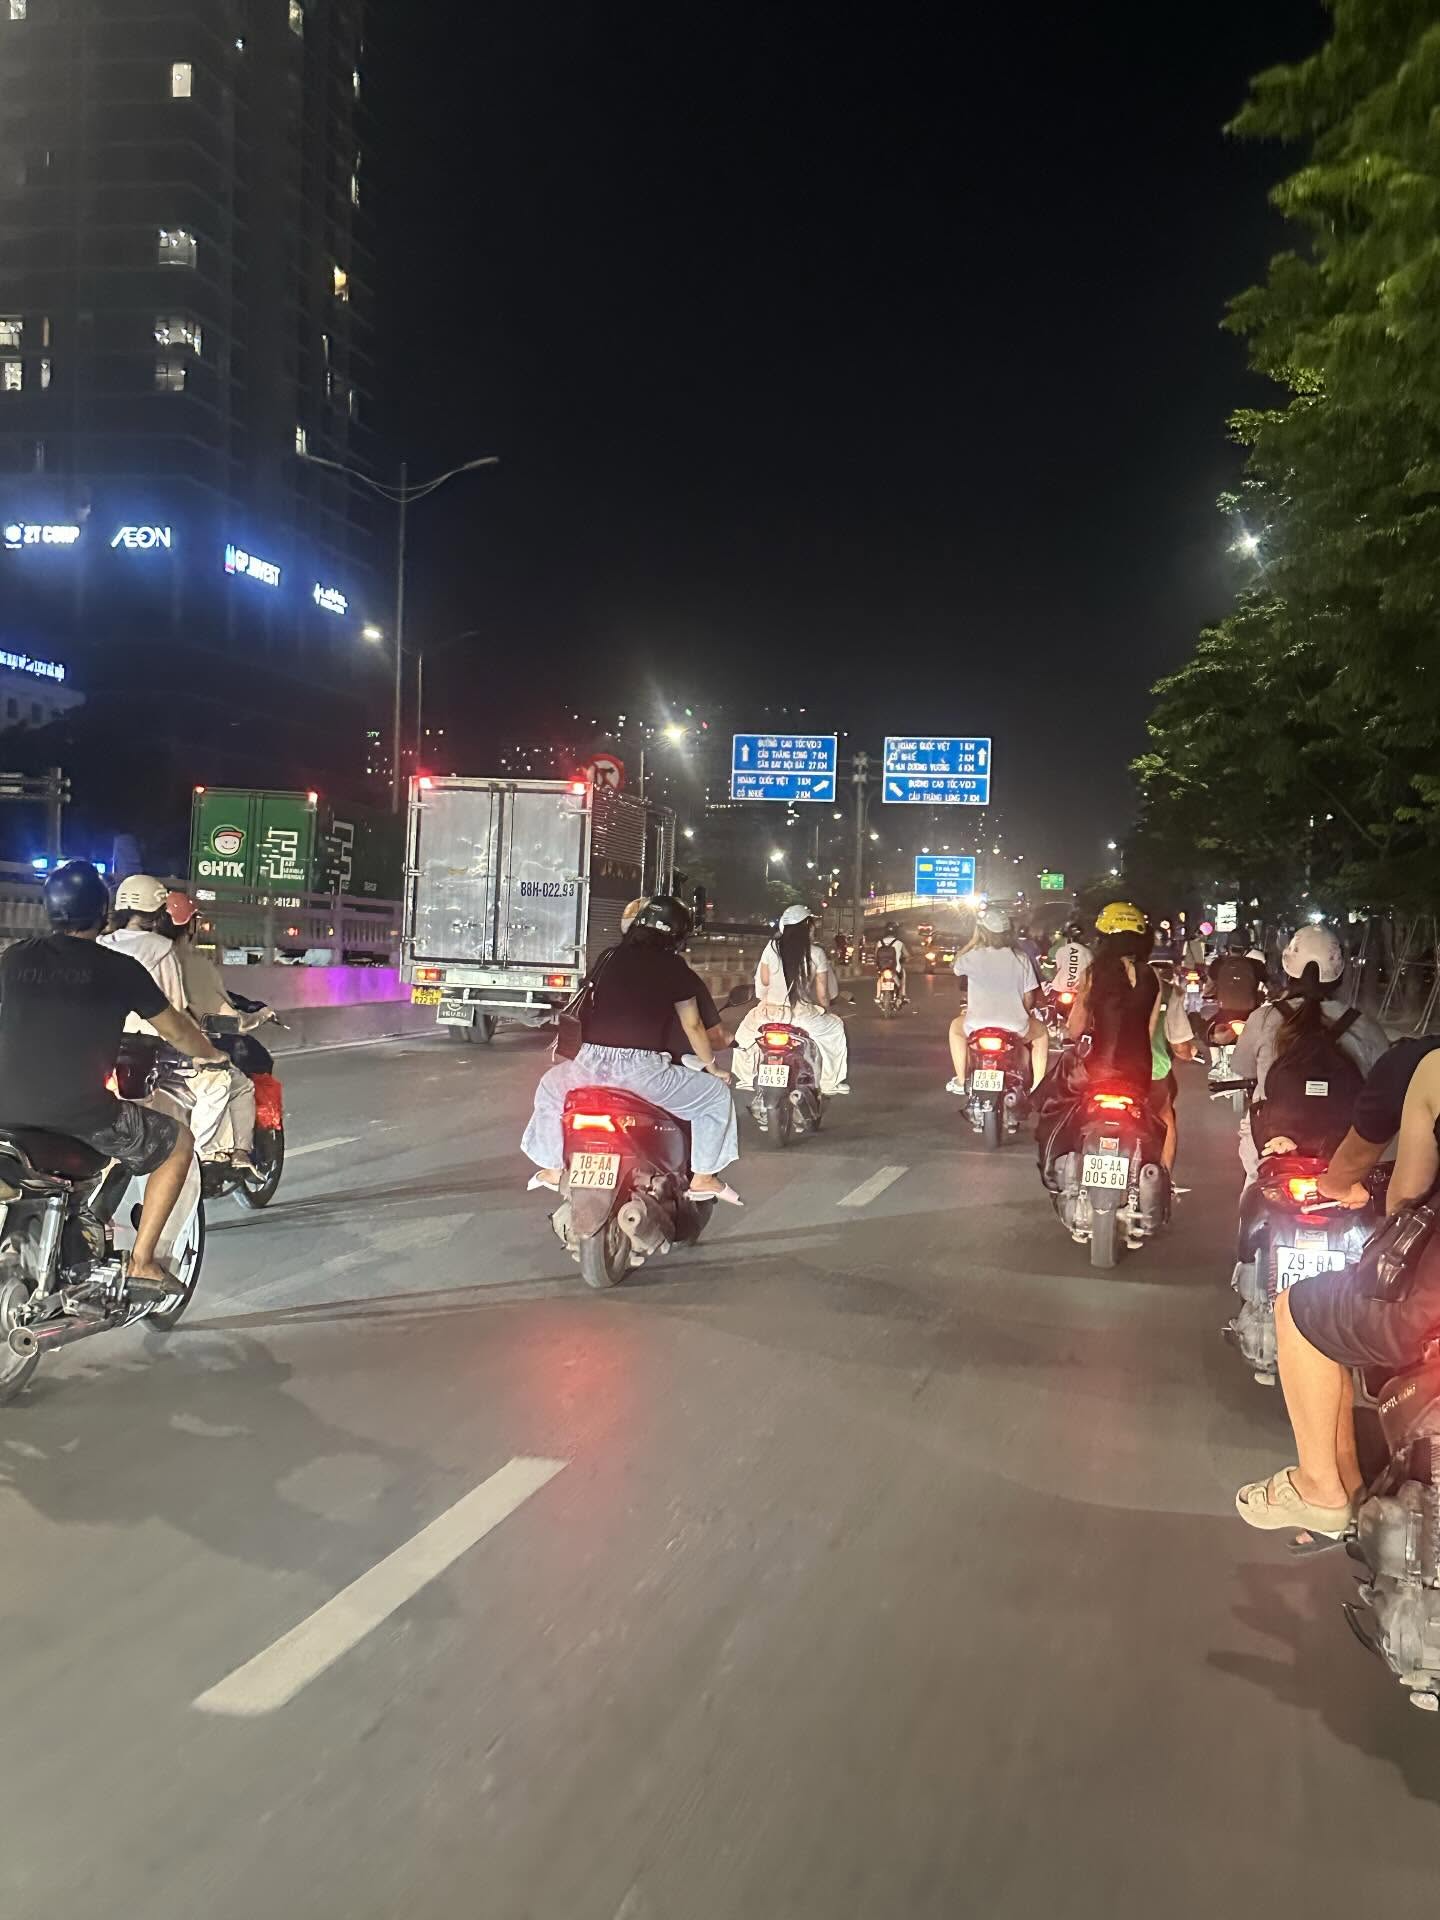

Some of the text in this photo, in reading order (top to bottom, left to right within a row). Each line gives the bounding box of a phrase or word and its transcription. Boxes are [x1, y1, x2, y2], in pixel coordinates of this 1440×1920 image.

[198, 860, 245, 878] GHTK
[521, 882, 575, 897] 88H-022.93
[580, 1155, 612, 1170] 18-AA
[1091, 1158, 1121, 1171] 90-AA
